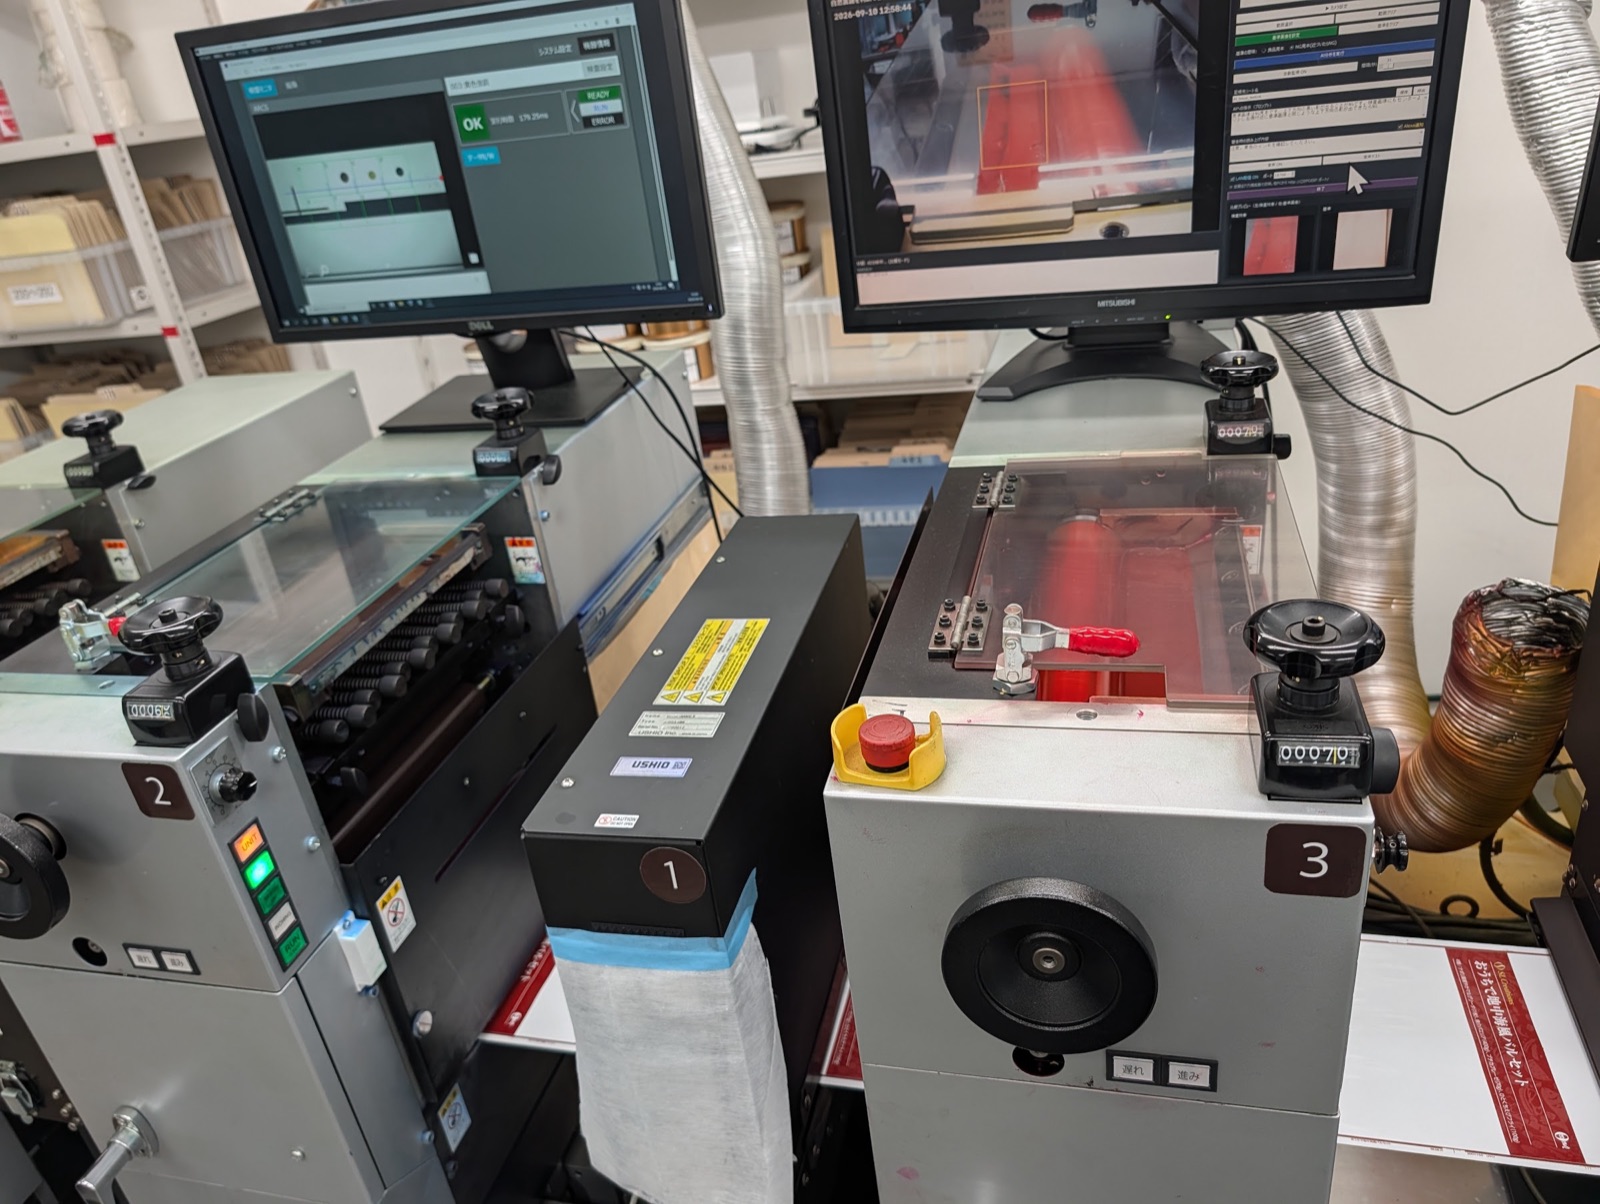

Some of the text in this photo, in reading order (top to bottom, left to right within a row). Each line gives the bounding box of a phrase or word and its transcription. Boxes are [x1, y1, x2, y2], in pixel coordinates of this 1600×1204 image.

[834, 9, 878, 21] 2026-09-10
[879, 3, 912, 15] 12:58:44
[586, 90, 610, 100] READY
[462, 117, 484, 131] OK
[591, 116, 615, 127] ERROR
[1097, 299, 1136, 307] MITSUBISHI
[468, 320, 494, 331] DELL
[632, 760, 670, 769] USHIO
[145, 777, 172, 805] 2
[241, 832, 259, 852] UNIT
[1299, 842, 1329, 878] 3
[663, 861, 679, 890] 1
[284, 933, 300, 954] RUN
[1474, 959, 1529, 1087] おうちで地中海風バルセット
[1122, 1064, 1144, 1076] 遅れ
[1177, 1070, 1200, 1082] 進み
